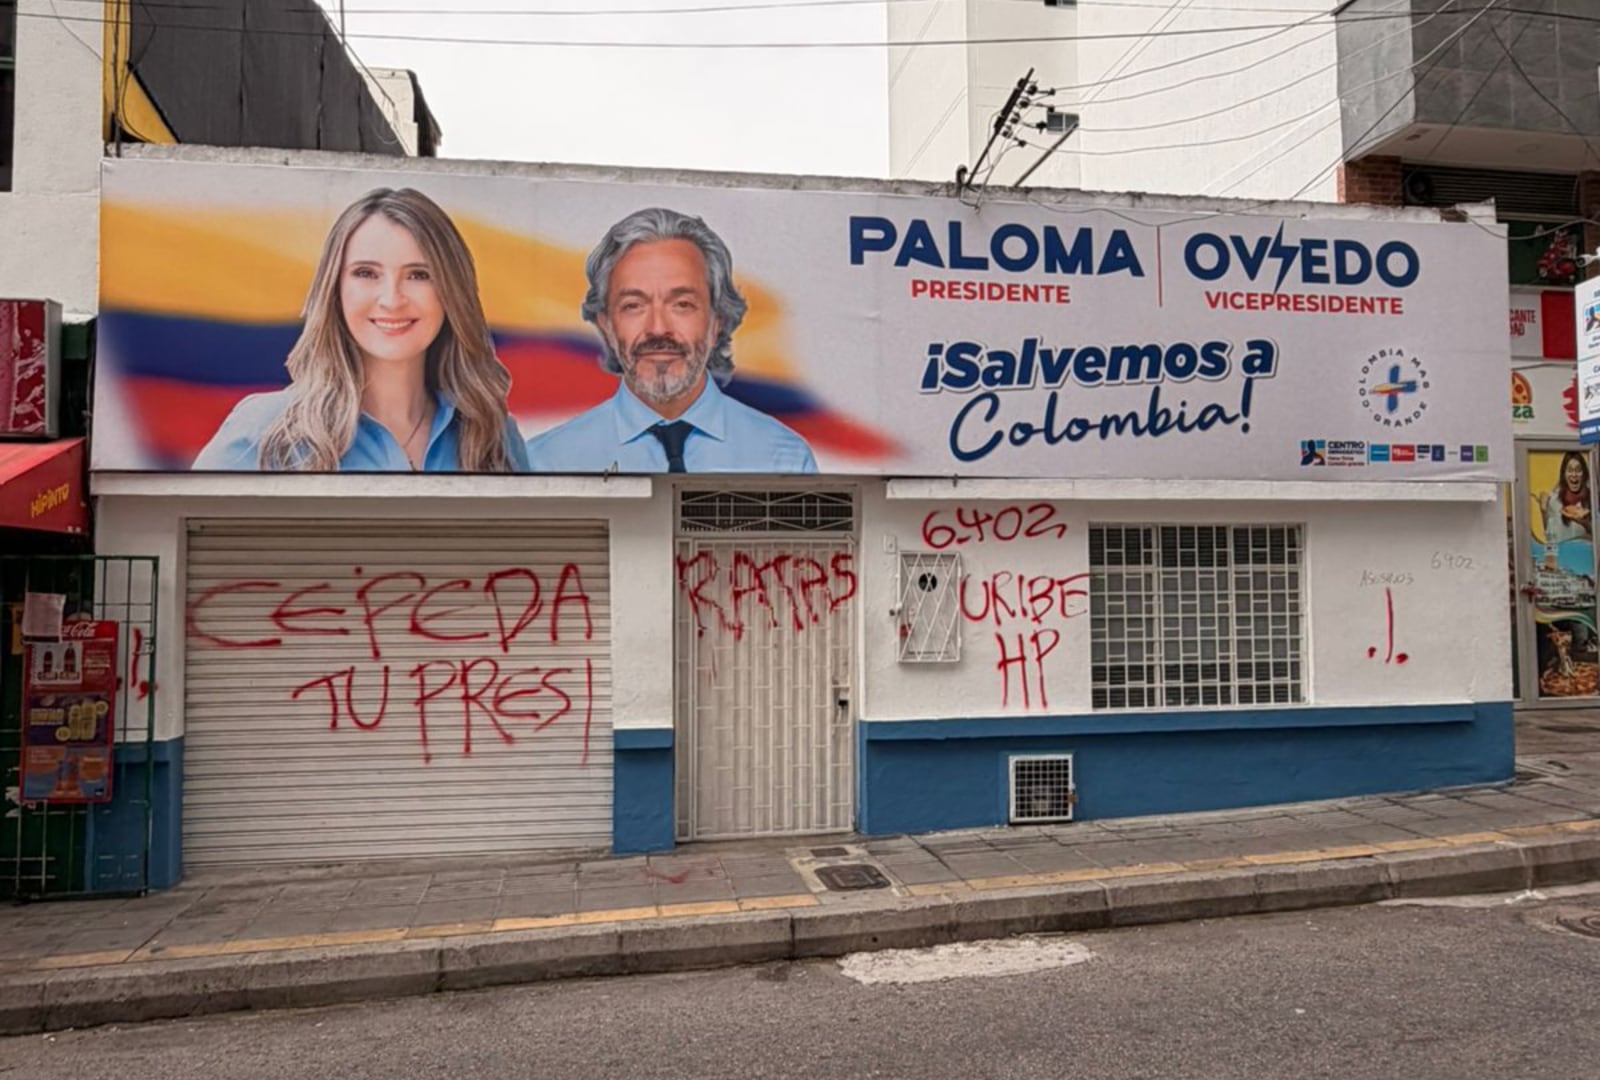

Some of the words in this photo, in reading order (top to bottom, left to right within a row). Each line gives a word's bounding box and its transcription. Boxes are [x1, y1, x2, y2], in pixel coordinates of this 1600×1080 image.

[850, 216, 1145, 277] PALOMA
[911, 279, 1071, 304] PRESIDENTE
[1205, 291, 1404, 315] VICEPRESIDENTE
[919, 337, 1232, 392] ¡Salvemos
[1241, 338, 1278, 378] a
[950, 377, 1254, 463] Colombia!
[959, 570, 1094, 628] URIBE
[292, 665, 390, 732] TU
[995, 629, 1061, 710] HP
